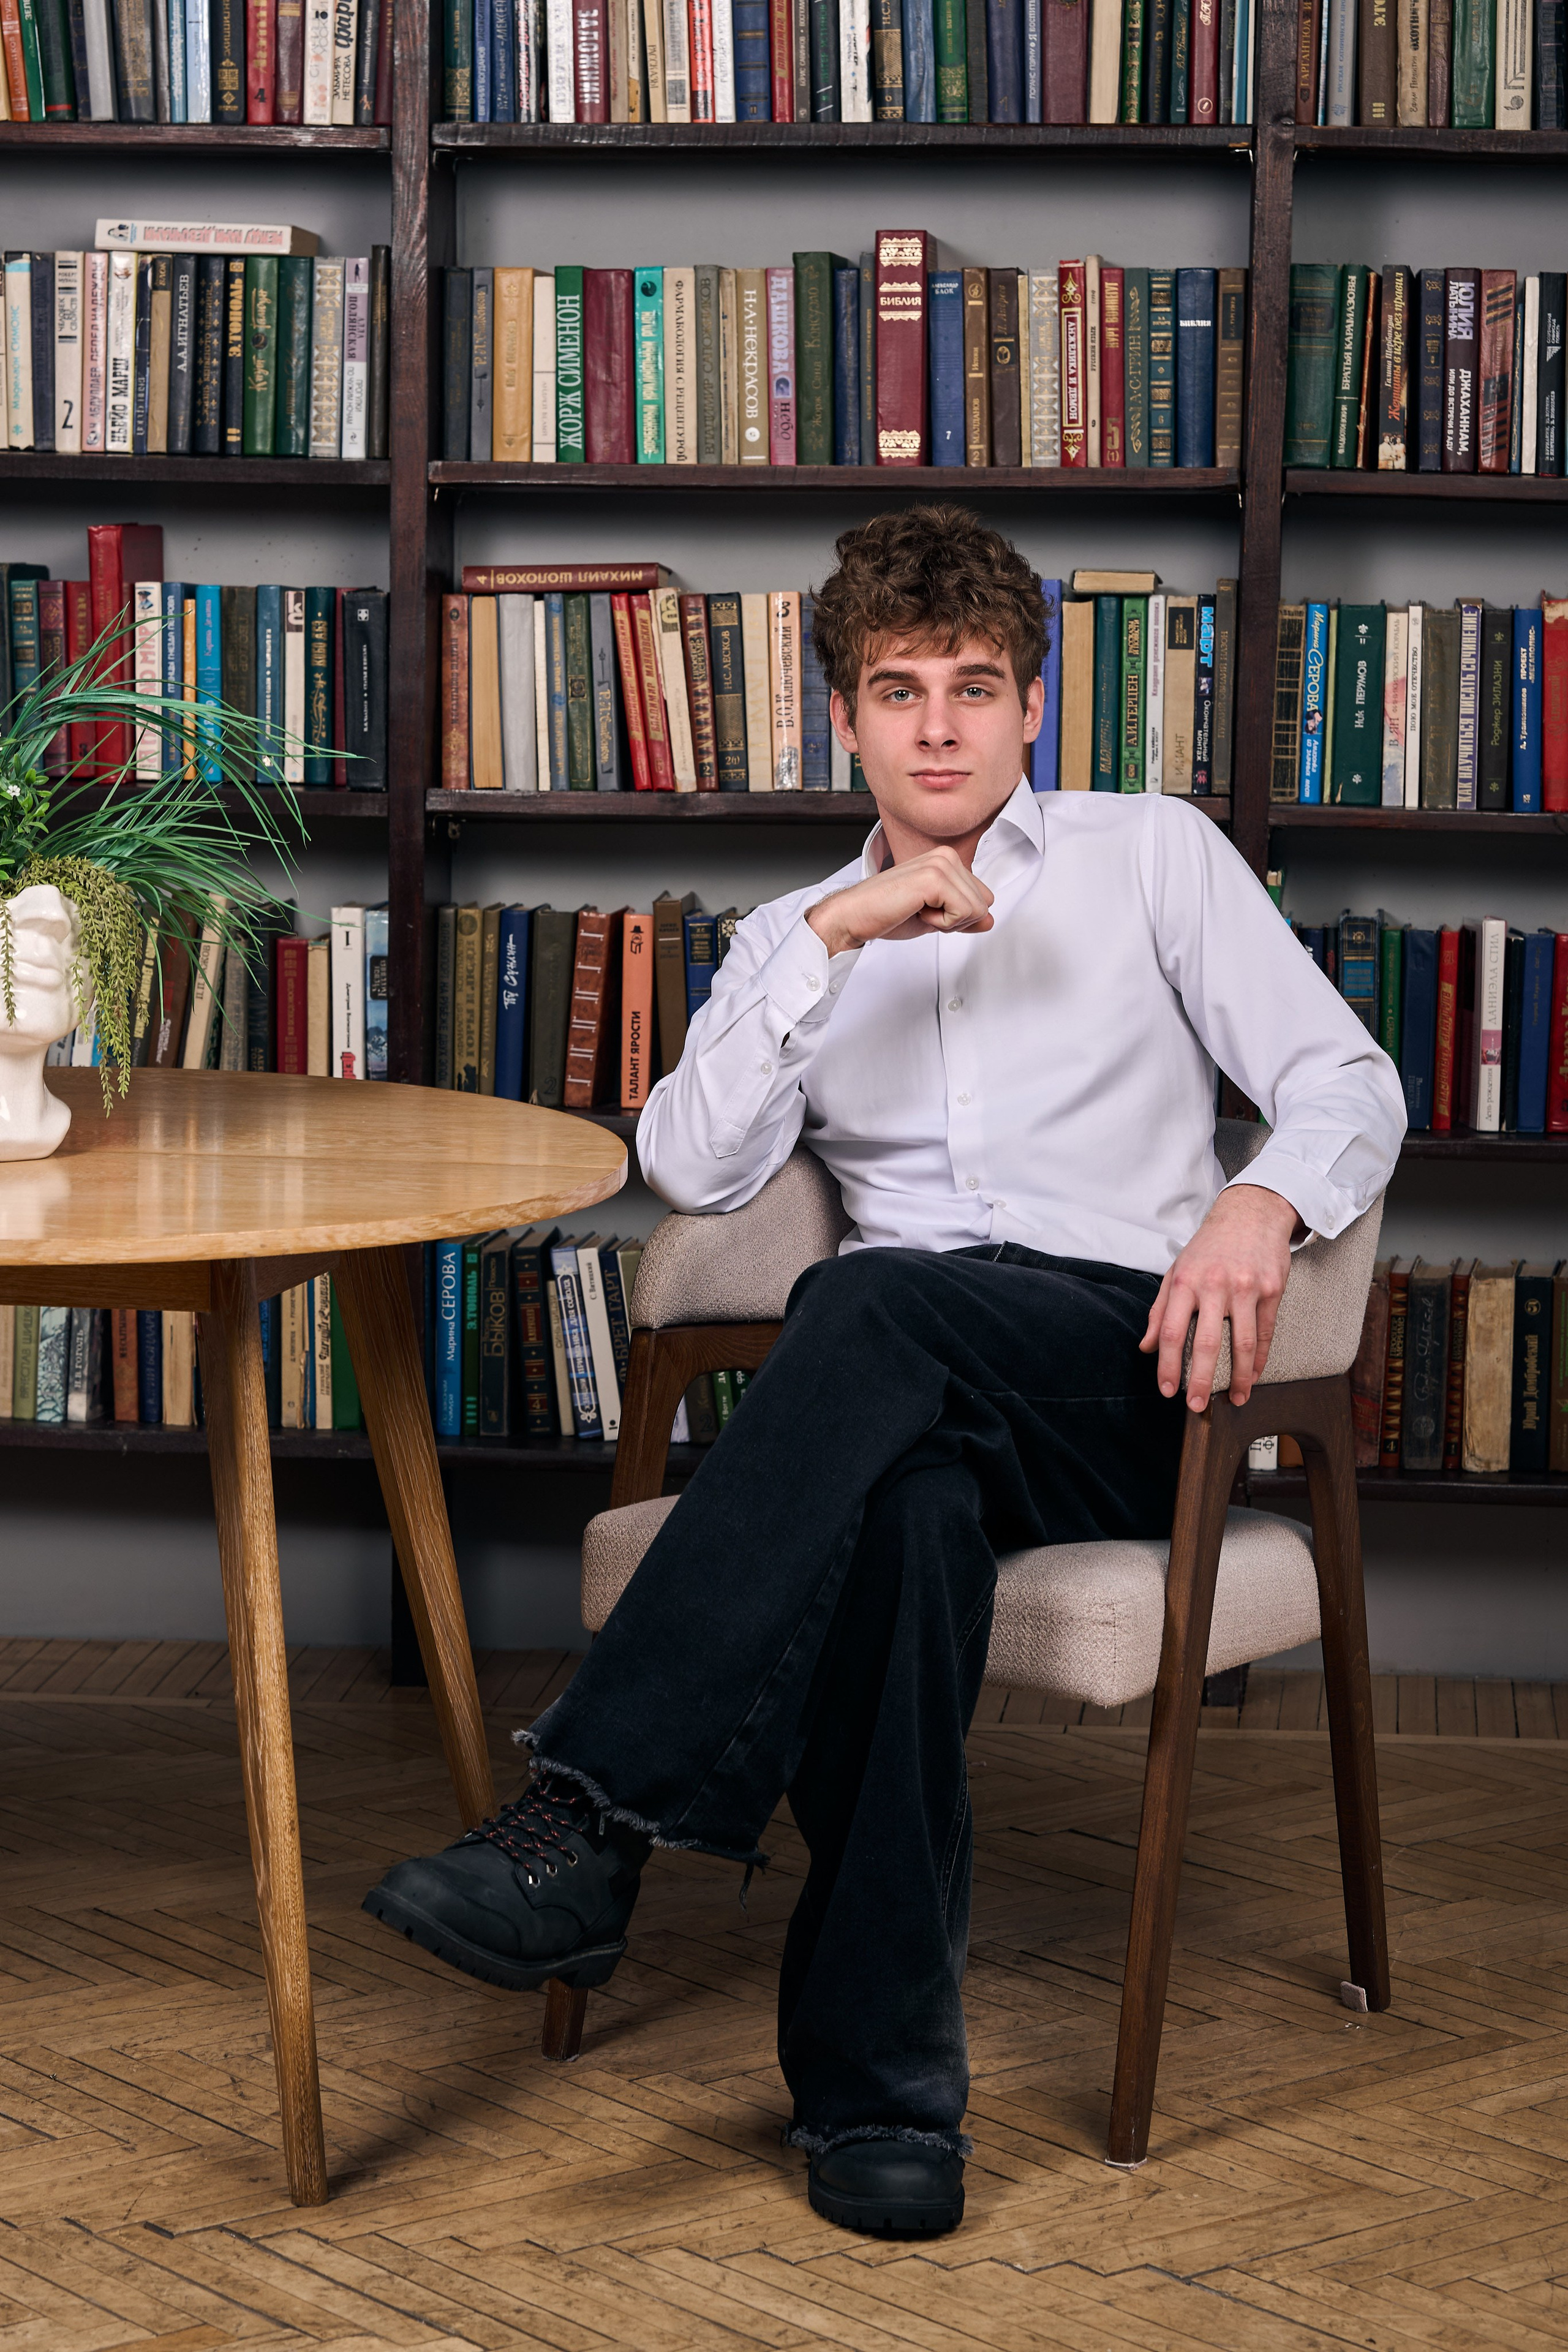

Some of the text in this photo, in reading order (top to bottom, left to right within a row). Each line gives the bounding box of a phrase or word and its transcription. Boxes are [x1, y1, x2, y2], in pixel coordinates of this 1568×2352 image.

[342, 55, 352, 101] НЕТЕСОВА
[1300, 18, 1311, 87] ГАРГАНТЮА
[228, 278, 243, 357] Э.ТОПОЛЬ
[880, 296, 922, 306] БИБЛИЯ
[1393, 272, 1404, 312] правил
[1447, 281, 1458, 341] ЛАТЫНИНА
[1456, 282, 1476, 341] ЮЛИЯ
[10, 305, 20, 352] СИМОНС
[347, 296, 356, 359] ПОЛЯНСКАЯ
[675, 280, 685, 374] ФАРМАКОЛОГИЯ
[770, 276, 789, 375] ДАШКОВА
[1067, 321, 1076, 375] АНЖЕЛИКА
[1105, 327, 1119, 348] КУРТ
[1340, 275, 1357, 390] БРАТЬЯ КАРАМАЗОВЫ
[1392, 313, 1403, 331] без
[1393, 331, 1406, 357] игре
[111, 357, 129, 398] МАРШ
[556, 295, 582, 450] ЖОРЖ СИМЕНОН
[699, 277, 715, 454] ВЛАДИМИР САПОЖНИКОВ
[1384, 314, 1395, 388] Галина Щербакова
[61, 400, 75, 429] 2
[1068, 386, 1078, 420] ДЕМОН
[1387, 365, 1403, 421] Женщины
[1447, 397, 1455, 426] ВСТРЕЧИ
[1457, 369, 1472, 456] ДЖАХАННАМ,
[676, 386, 687, 461] РЕЦЕПТУРОЙ
[1106, 417, 1119, 450] 5
[496, 572, 573, 585] ШОЛОХОВ
[578, 570, 643, 584] МИХАИЛ
[1311, 611, 1324, 649] Марина
[1355, 660, 1367, 704] ПЕРУМОВ
[1457, 610, 1478, 802] КАК НАУЧИТЬСЯ ПИСАТЬ СОЧИНЕНИЕ
[1491, 660, 1502, 746] Роджер ЗИЛАЗНИ
[1200, 699, 1212, 762] Окончательный
[1310, 739, 1319, 772] Амазонка
[1487, 933, 1499, 1025] ДАНИЭЛА СТИЛ
[465, 1008, 475, 1058] ГОРЫ
[628, 1011, 640, 1100] ТАЛАНТ ЯРОСТИ
[440, 1251, 456, 1321] СЕРОВА
[604, 1269, 621, 1312] ГАРТ
[446, 1321, 457, 1361] Марина
[484, 1291, 505, 1357] БЫКОВ
[571, 1329, 586, 1375] ПРИМАНКА
[1522, 1334, 1541, 1430] Юрий Домбровский
